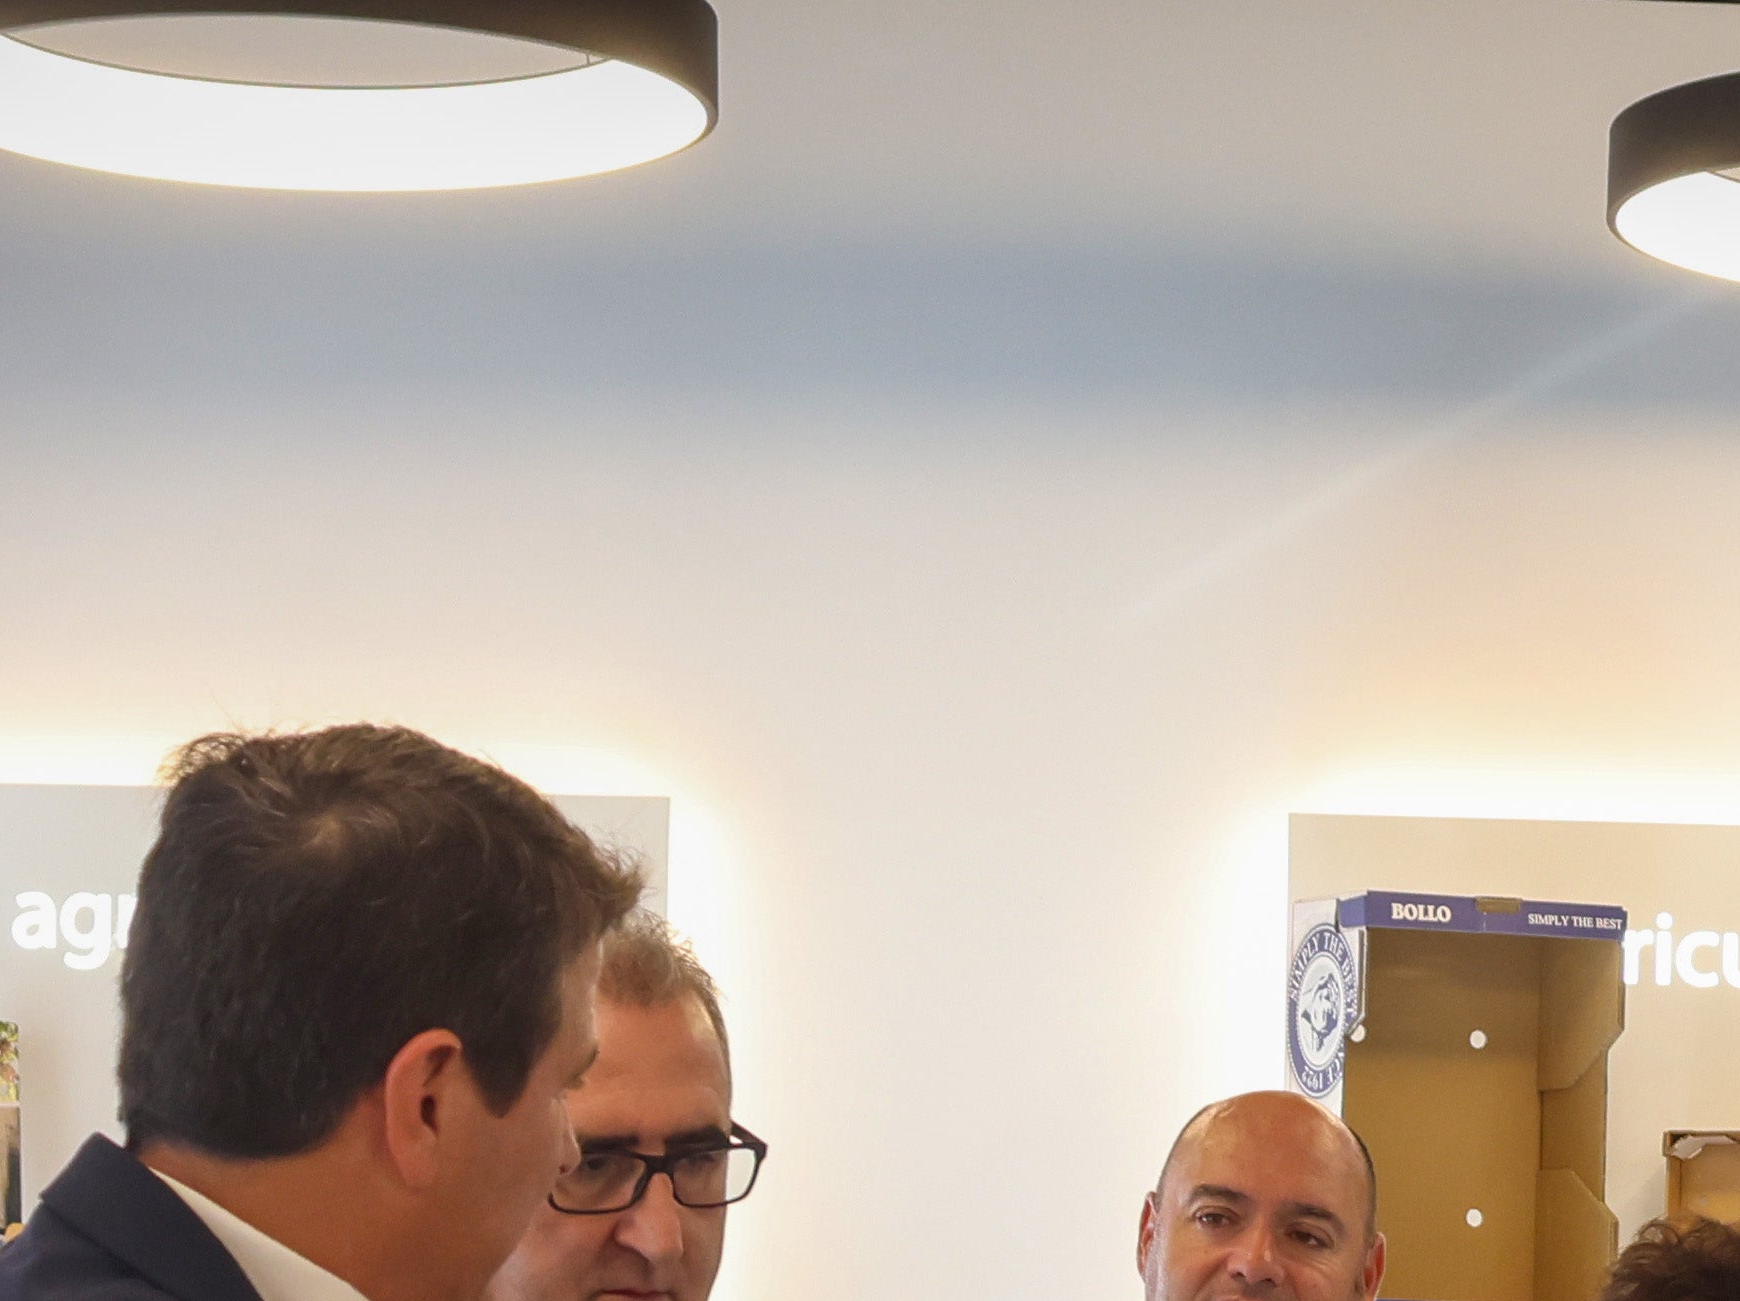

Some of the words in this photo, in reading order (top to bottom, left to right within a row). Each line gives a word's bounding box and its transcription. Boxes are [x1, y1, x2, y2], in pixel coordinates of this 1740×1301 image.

[1391, 902, 1452, 923] BOLLO
[1527, 913, 1569, 927] SIMPLY
[1571, 916, 1594, 928] THE
[1595, 918, 1623, 931] BEST
